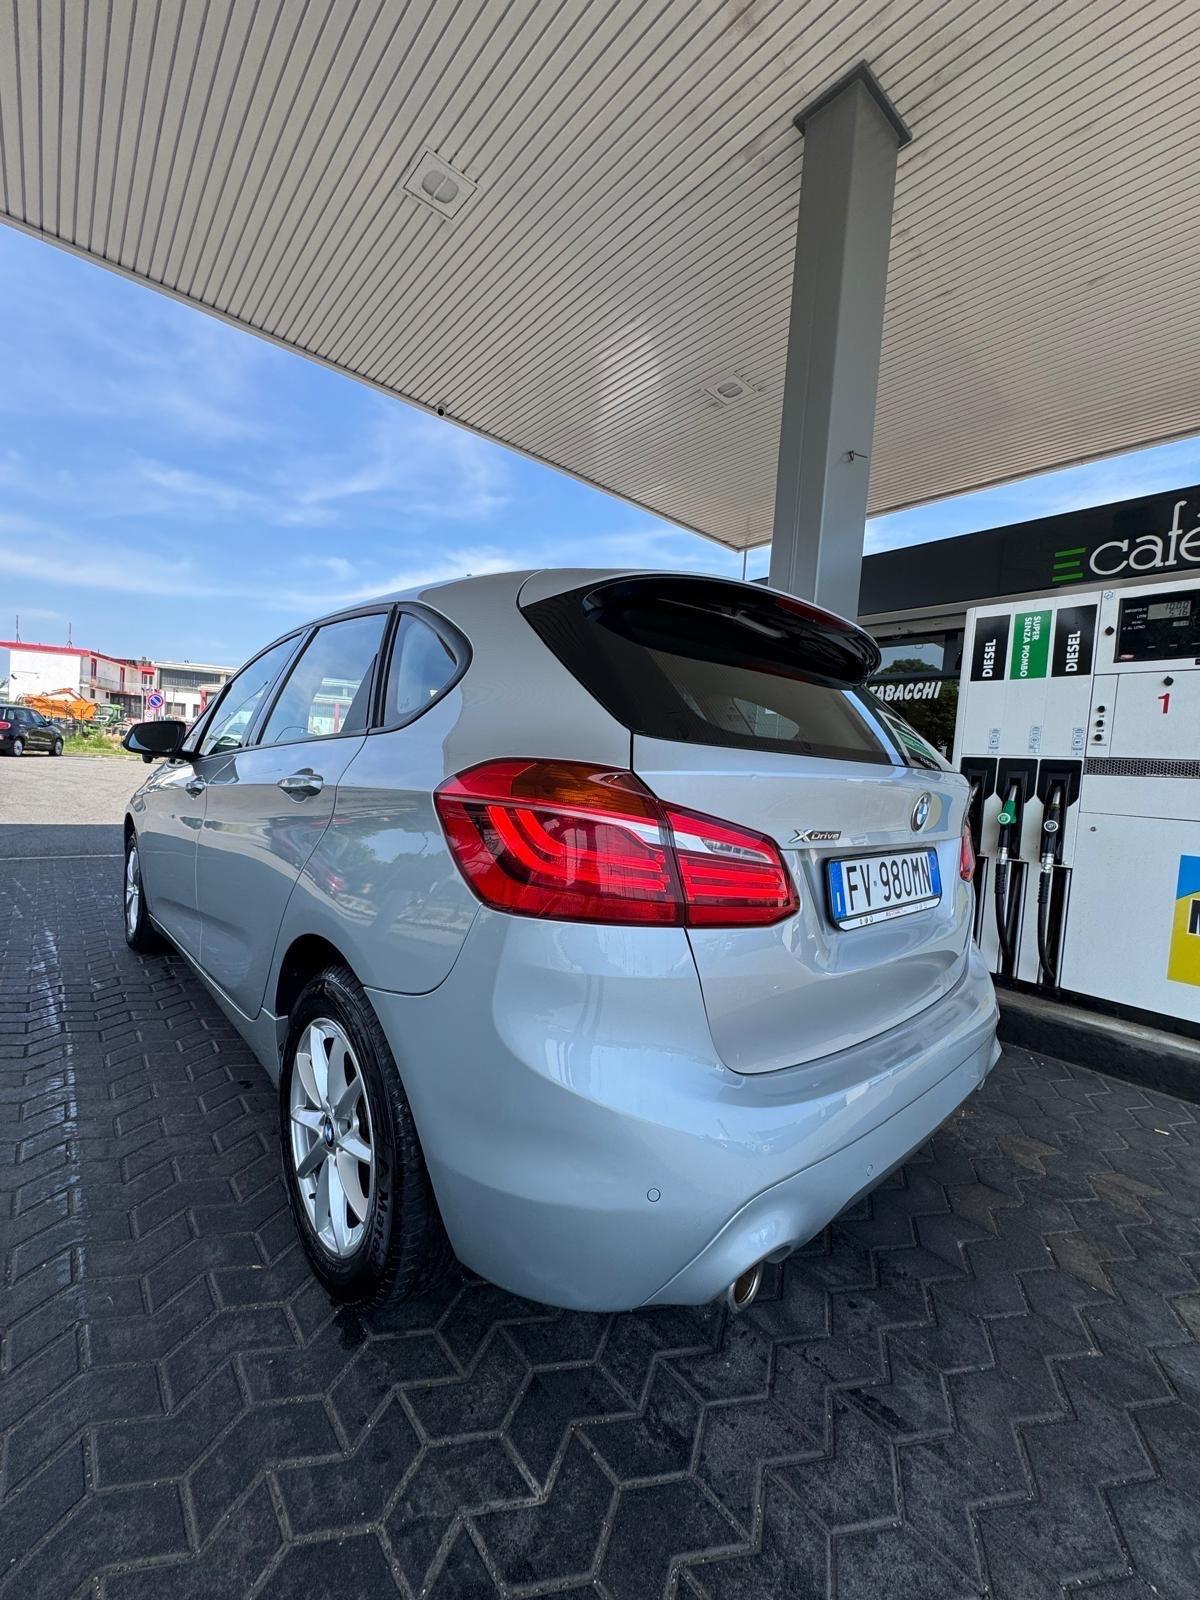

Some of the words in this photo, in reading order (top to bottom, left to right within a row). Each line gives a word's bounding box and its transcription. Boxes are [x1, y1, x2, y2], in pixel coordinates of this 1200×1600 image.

[1022, 616, 1033, 644] SENZA
[1032, 616, 1042, 641] SUPER
[982, 639, 997, 678] DIESEL
[1019, 645, 1030, 678] PIOMBO
[1065, 630, 1081, 672] DIESEL
[1157, 693, 1171, 714] 1
